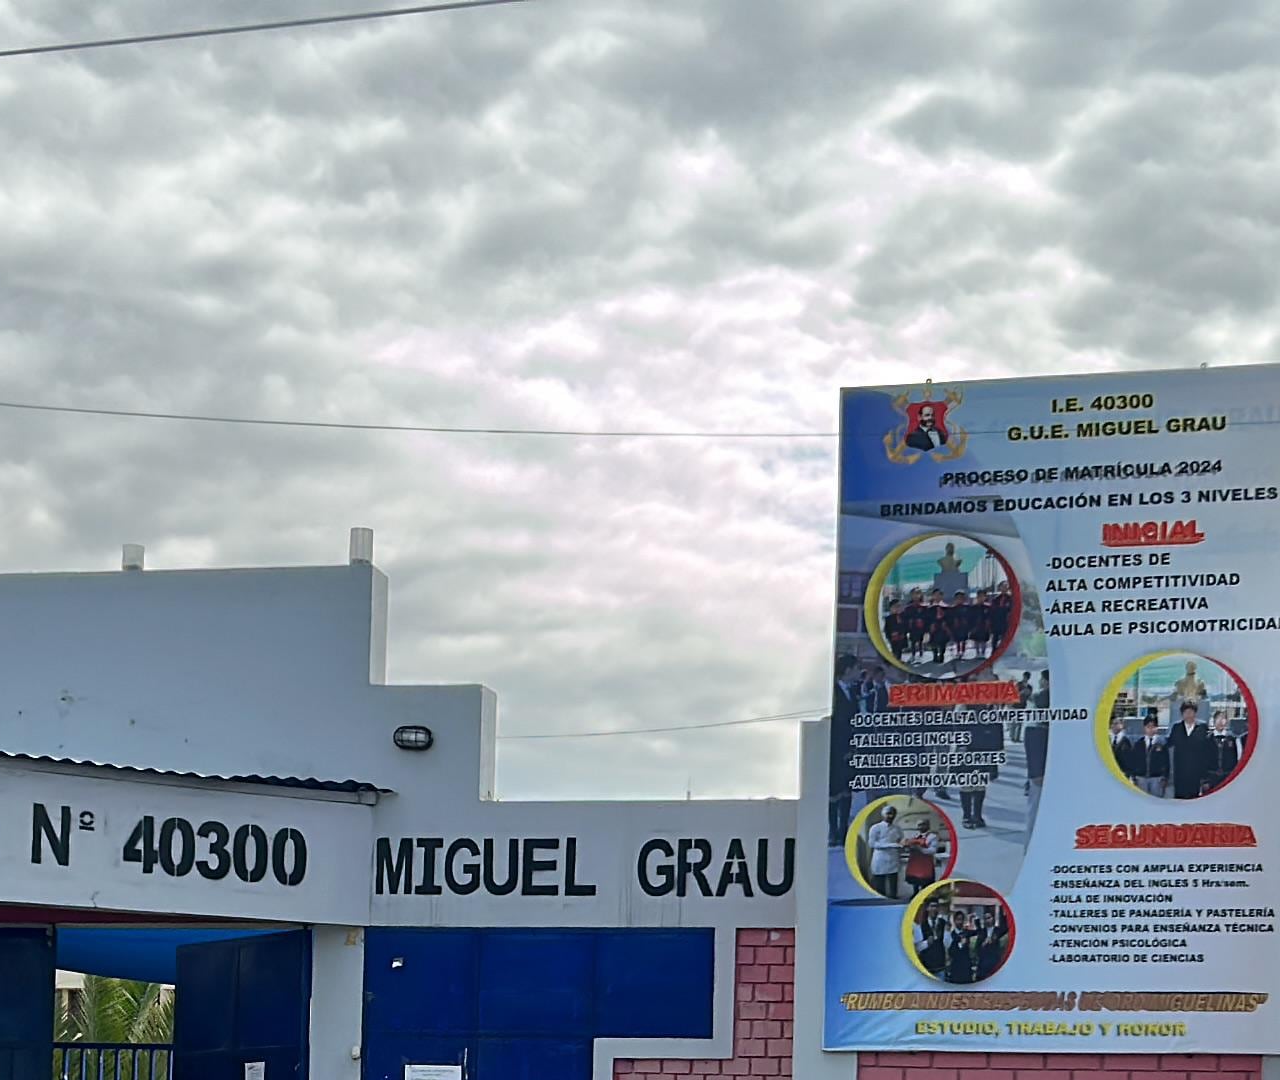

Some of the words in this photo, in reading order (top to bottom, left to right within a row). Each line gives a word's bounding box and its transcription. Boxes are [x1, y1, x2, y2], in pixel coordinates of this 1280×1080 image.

[1052, 397, 1084, 413] I.E.
[1090, 394, 1154, 411] 40300
[1008, 424, 1069, 441] G.U.E.
[1077, 419, 1159, 438] MIGUEL
[1166, 416, 1227, 433] GRAU
[941, 468, 1029, 486] PROCESO
[1033, 467, 1059, 482] DE
[1064, 461, 1172, 480] MATRÍCULA
[1176, 459, 1223, 475] 2024
[880, 500, 988, 517] BRINDAMOS
[993, 492, 1101, 512] EDUCACIÓN
[1107, 493, 1132, 507] EN
[1139, 490, 1175, 506] LOS
[1181, 490, 1192, 504] 3
[1197, 487, 1279, 503] NIVELES
[1148, 552, 1171, 566] DE
[1046, 577, 1088, 592] ALTA
[1093, 572, 1241, 591] COMPETITIVIDAD
[1101, 597, 1209, 613] RECREATIVA
[1100, 621, 1123, 635] DE
[889, 681, 1020, 705] PRIMARIA
[924, 711, 944, 725] DE
[944, 710, 976, 725] ALTA
[979, 708, 1089, 723] COMPETITIVIDAD
[904, 733, 922, 746] DE
[920, 753, 938, 766] DE
[939, 751, 1007, 766] DEPORTES
[889, 774, 908, 788] DE
[909, 770, 991, 788] INNOVACIÓN
[1075, 822, 1258, 847] SECUNDARIA
[122, 814, 308, 887] 40300
[374, 836, 597, 897] MIGUEL
[636, 837, 797, 898] GRAU
[1115, 864, 1139, 874] CON
[1143, 863, 1185, 874] AMPLIA
[1187, 862, 1264, 873] EXPERIENCIA
[1123, 879, 1145, 888] DEL
[1085, 894, 1100, 903] DE
[1111, 909, 1126, 918] DE
[1195, 908, 1204, 918] Y
[1120, 924, 1150, 933] PARA
[1152, 922, 1222, 933] ENSEÑANZA
[1132, 953, 1148, 963] DE
[1150, 953, 1205, 963] CIENCIAS
[1006, 1020, 1095, 1037] TRABAJO
[1098, 1021, 1112, 1037] Y
[1117, 1021, 1187, 1037] HONOR
